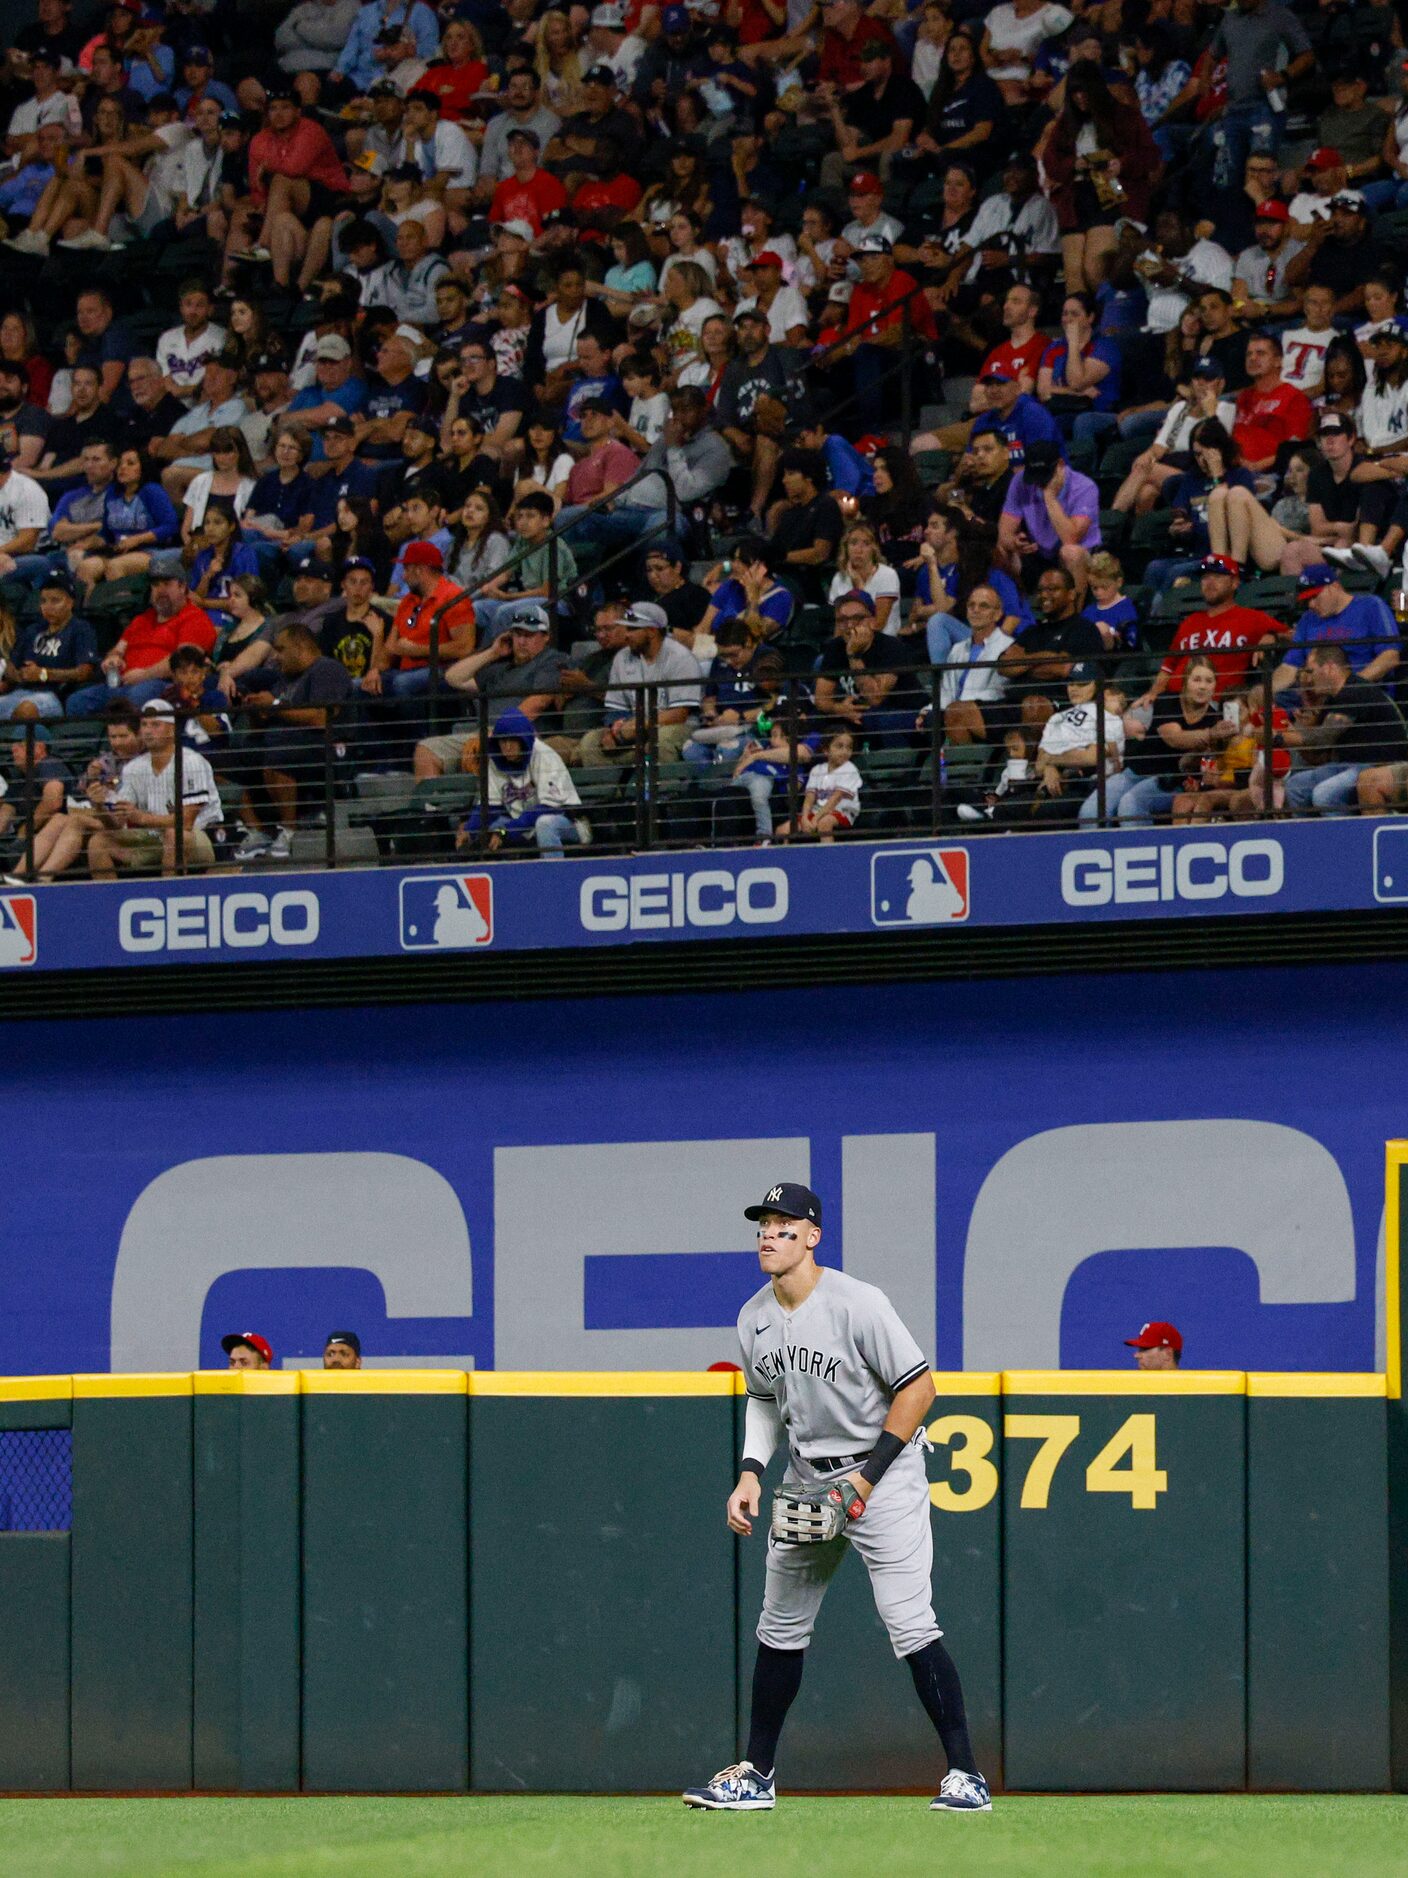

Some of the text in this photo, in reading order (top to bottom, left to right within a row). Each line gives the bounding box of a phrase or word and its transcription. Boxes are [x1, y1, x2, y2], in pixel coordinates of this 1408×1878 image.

[581, 868, 790, 932] GEICO
[1062, 841, 1285, 907] GEICO
[121, 892, 320, 953] GEICO
[767, 1186, 784, 1202] NY
[110, 1120, 1387, 1372] GEIC
[754, 1344, 843, 1384] NEW YORK
[927, 1415, 1169, 1513] 374
